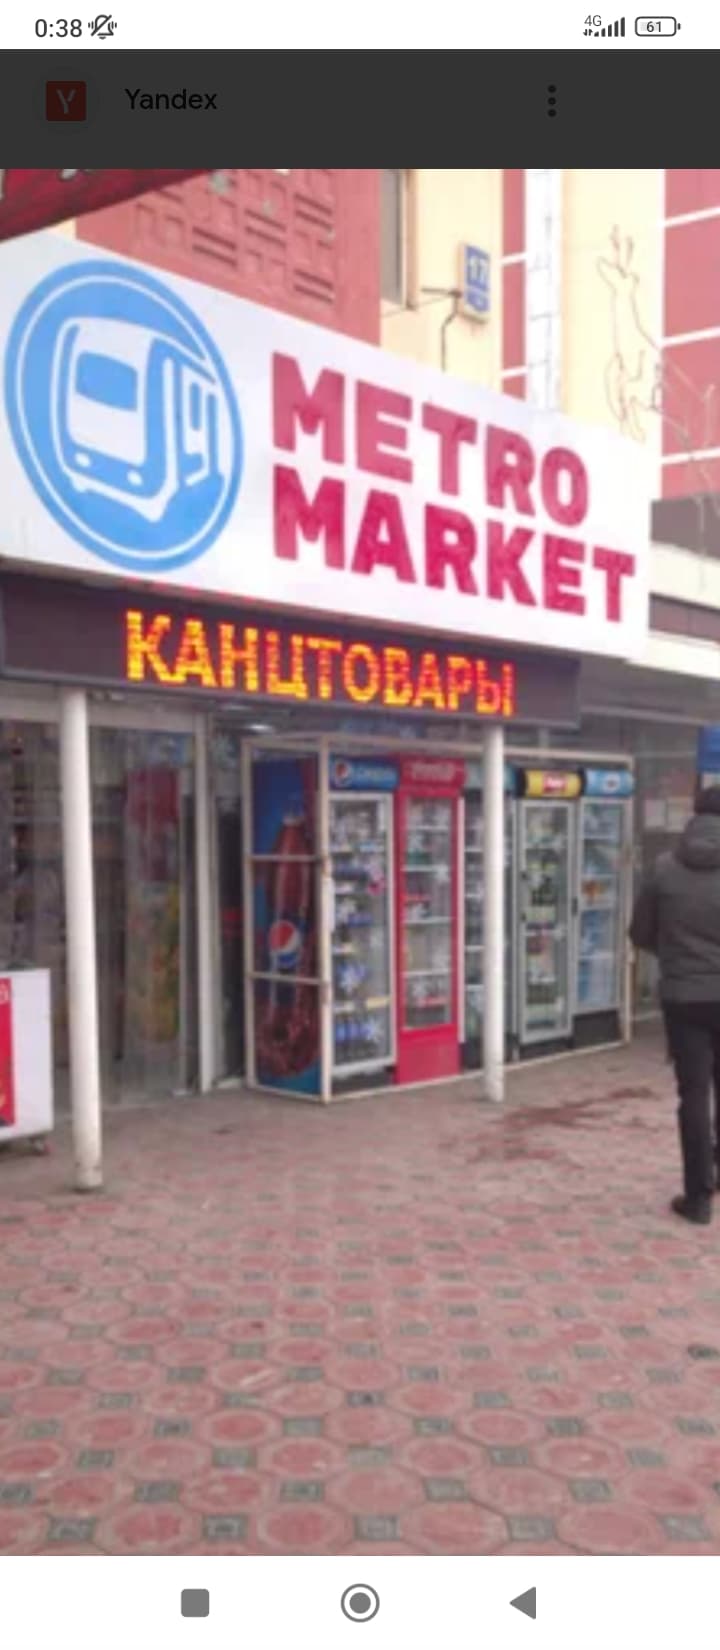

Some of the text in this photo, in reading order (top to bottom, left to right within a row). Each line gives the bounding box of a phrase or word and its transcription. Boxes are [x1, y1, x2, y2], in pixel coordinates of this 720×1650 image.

[272, 351, 589, 528] METRO
[272, 464, 636, 623] MARKET
[124, 609, 515, 717] КАНЦТОВАРЫ
